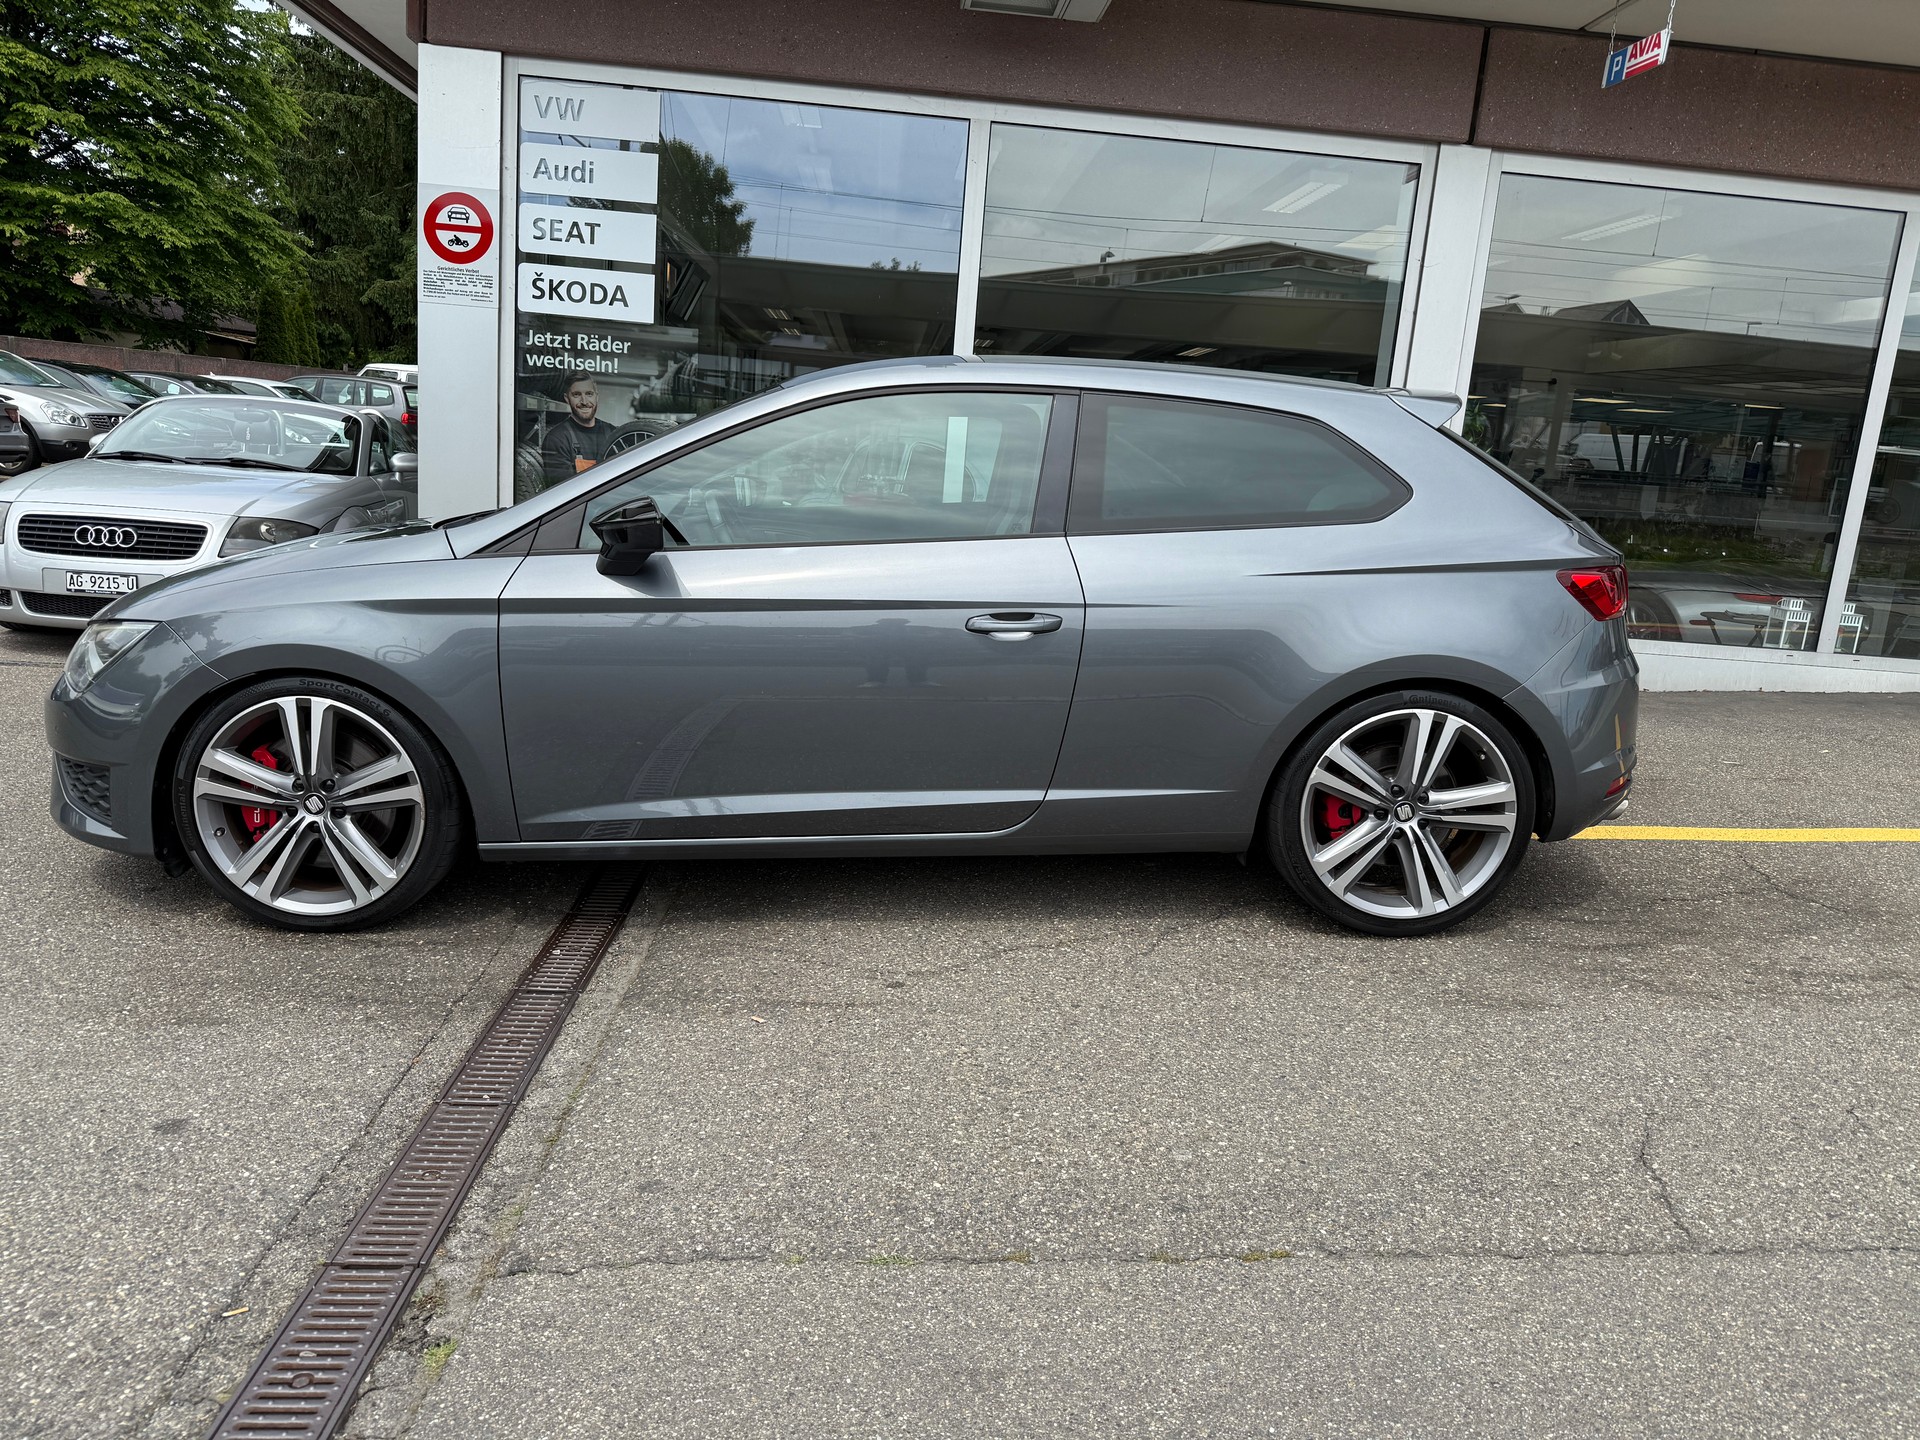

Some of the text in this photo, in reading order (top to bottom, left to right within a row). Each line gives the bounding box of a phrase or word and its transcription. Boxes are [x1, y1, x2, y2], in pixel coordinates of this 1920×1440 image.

[1611, 31, 1661, 81] P AVIA
[533, 95, 585, 121] VW
[532, 157, 594, 183] Audi
[532, 217, 601, 245] SEAT
[531, 271, 629, 307] ŠKODA
[525, 329, 632, 354] Jetzt Räder
[525, 352, 619, 373] wechseln!
[298, 679, 381, 710] SportContact
